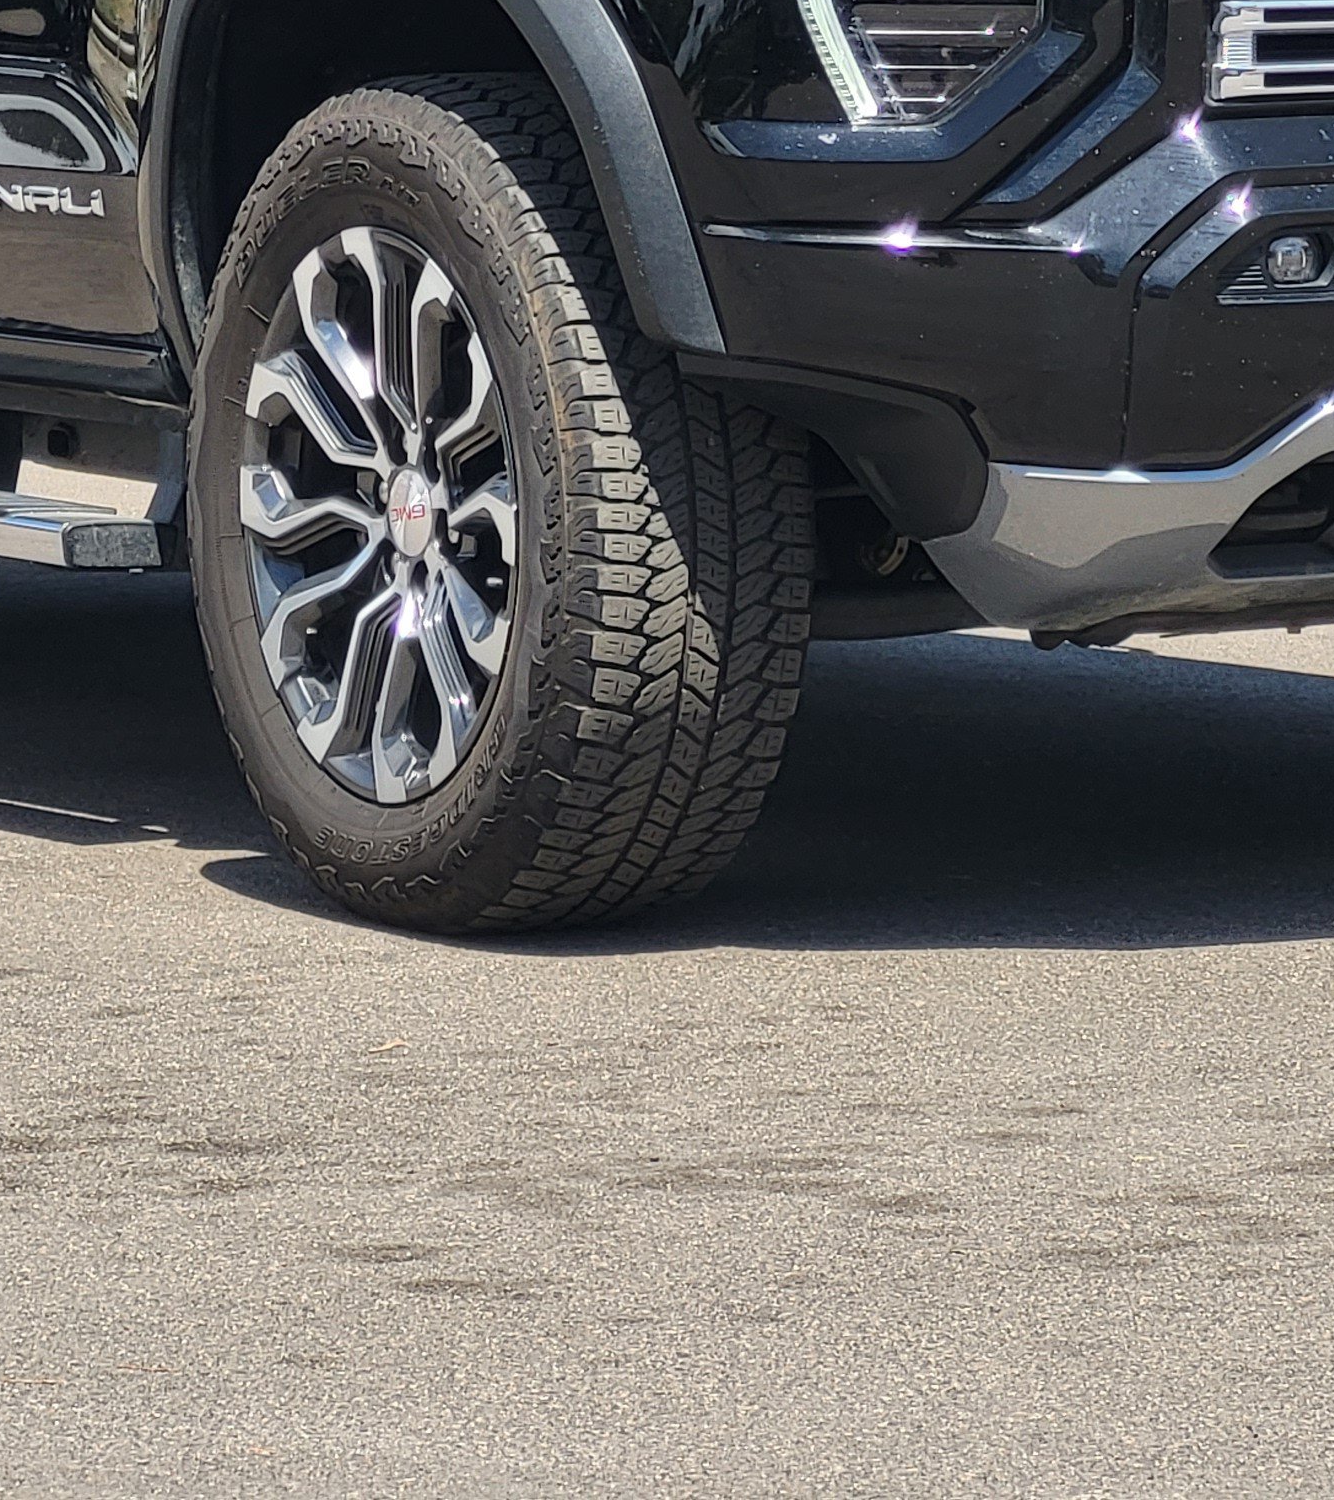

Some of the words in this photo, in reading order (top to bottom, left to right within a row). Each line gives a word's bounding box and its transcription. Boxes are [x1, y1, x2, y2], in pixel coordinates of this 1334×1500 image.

[235, 156, 371, 289] DUELER
[390, 503, 426, 523] GMC
[315, 712, 507, 866] BRIDGESTONE
